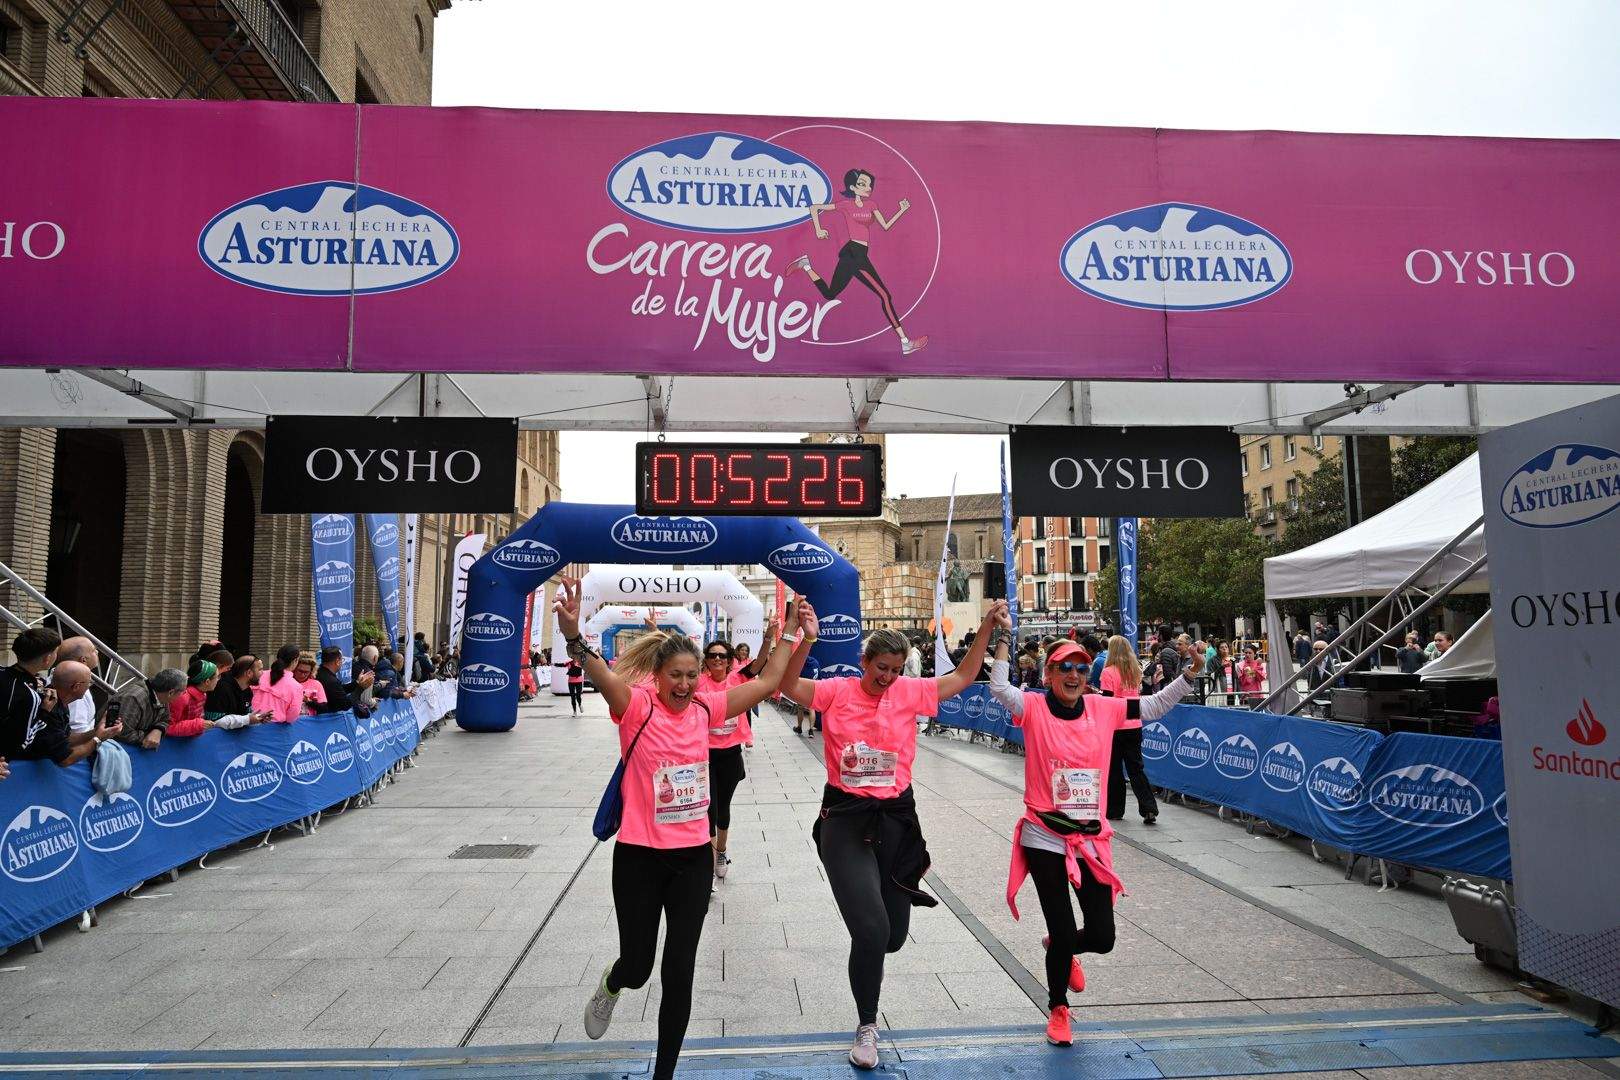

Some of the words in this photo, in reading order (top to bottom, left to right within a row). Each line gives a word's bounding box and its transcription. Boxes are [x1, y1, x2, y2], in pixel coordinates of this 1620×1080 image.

[660, 164, 731, 177] CENTRAL
[737, 167, 808, 179] LECHERA
[624, 166, 814, 208] ASTURIANA
[261, 220, 341, 232] CENTRAL
[350, 221, 433, 233] LECHERA
[218, 222, 440, 266] ASTURIANA
[586, 222, 773, 278] Carrera
[1114, 238, 1188, 251] CENTRAL
[1194, 240, 1267, 252] LECHERA
[1079, 241, 1276, 283] ASTURIANA
[1405, 249, 1575, 287] OYSHO
[631, 280, 667, 316] de
[675, 280, 699, 317] la
[692, 273, 841, 363] Mujer
[306, 447, 481, 484] OYSHO
[1049, 457, 1209, 490] OYSHO
[1526, 473, 1567, 488] CENTRAL
[1571, 462, 1618, 478] LECHERA
[619, 523, 710, 543] ASTURIANA
[496, 550, 554, 563] ASTURIANA
[774, 554, 829, 566] ASTURIANA
[618, 576, 701, 594] OYSHO
[1511, 590, 1620, 628] OYSH
[859, 757, 878, 765] 016
[1216, 748, 1254, 771] ASTURIANA
[227, 769, 279, 795] ASTURIANA
[676, 786, 695, 797] 016
[1072, 788, 1091, 796] 016
[153, 788, 213, 819] ASTURIANA
[1376, 782, 1473, 816] ASTURIANA
[85, 810, 141, 841] ASTURIANA
[8, 830, 77, 872] ASTURIANA
